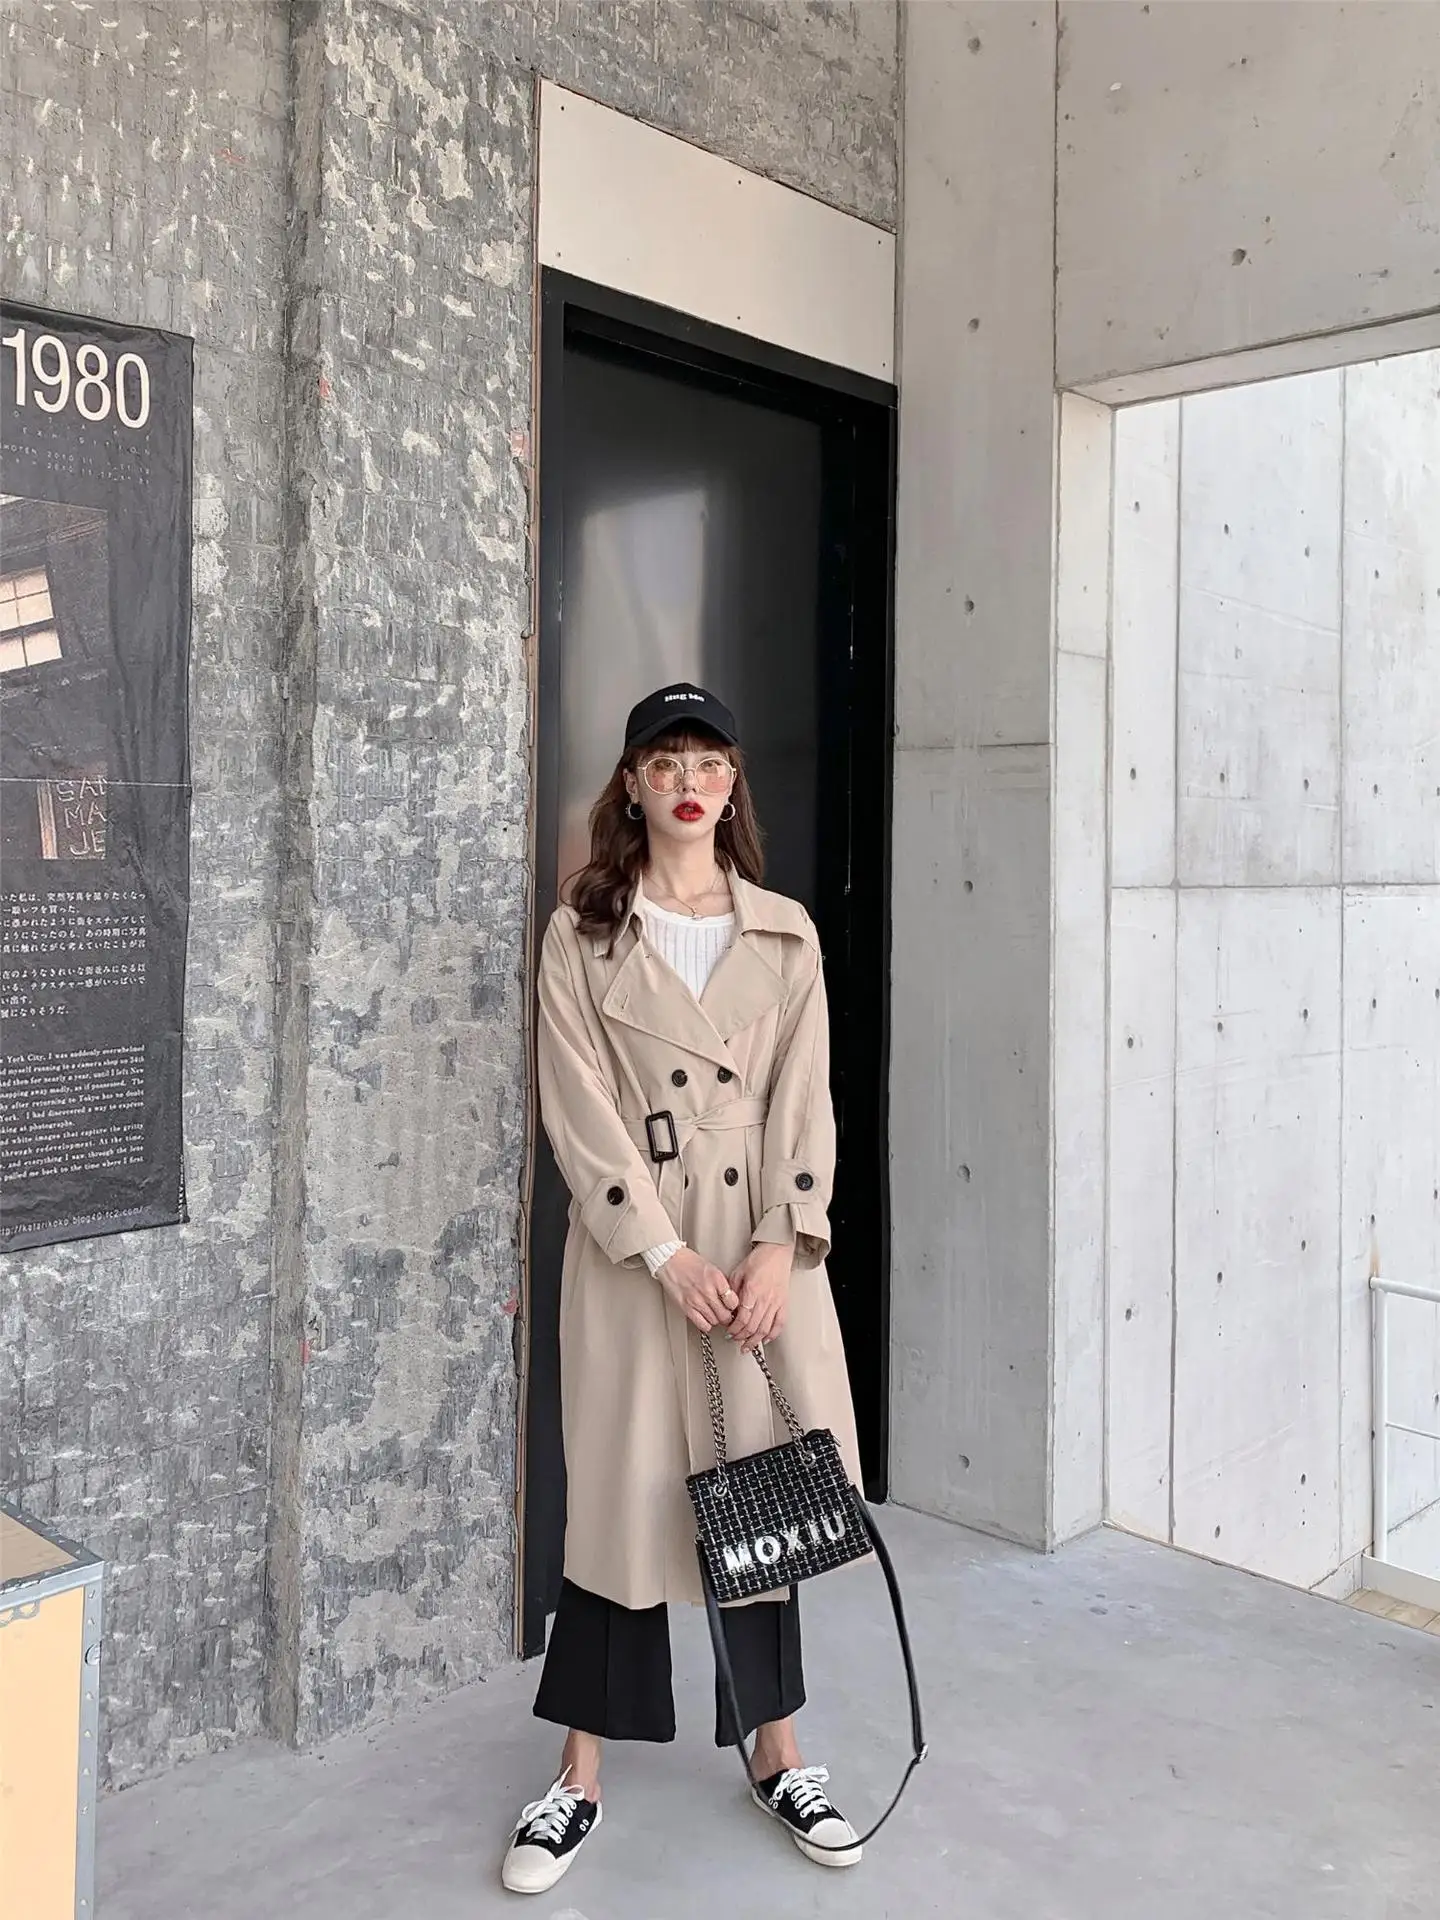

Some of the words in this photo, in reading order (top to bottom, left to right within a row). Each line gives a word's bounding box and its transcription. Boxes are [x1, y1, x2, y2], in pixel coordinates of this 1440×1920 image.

[2, 328, 150, 429] 1980
[64, 801, 107, 829] MA
[131, 1077, 144, 1085] The
[722, 1508, 846, 1577] MOXIU
